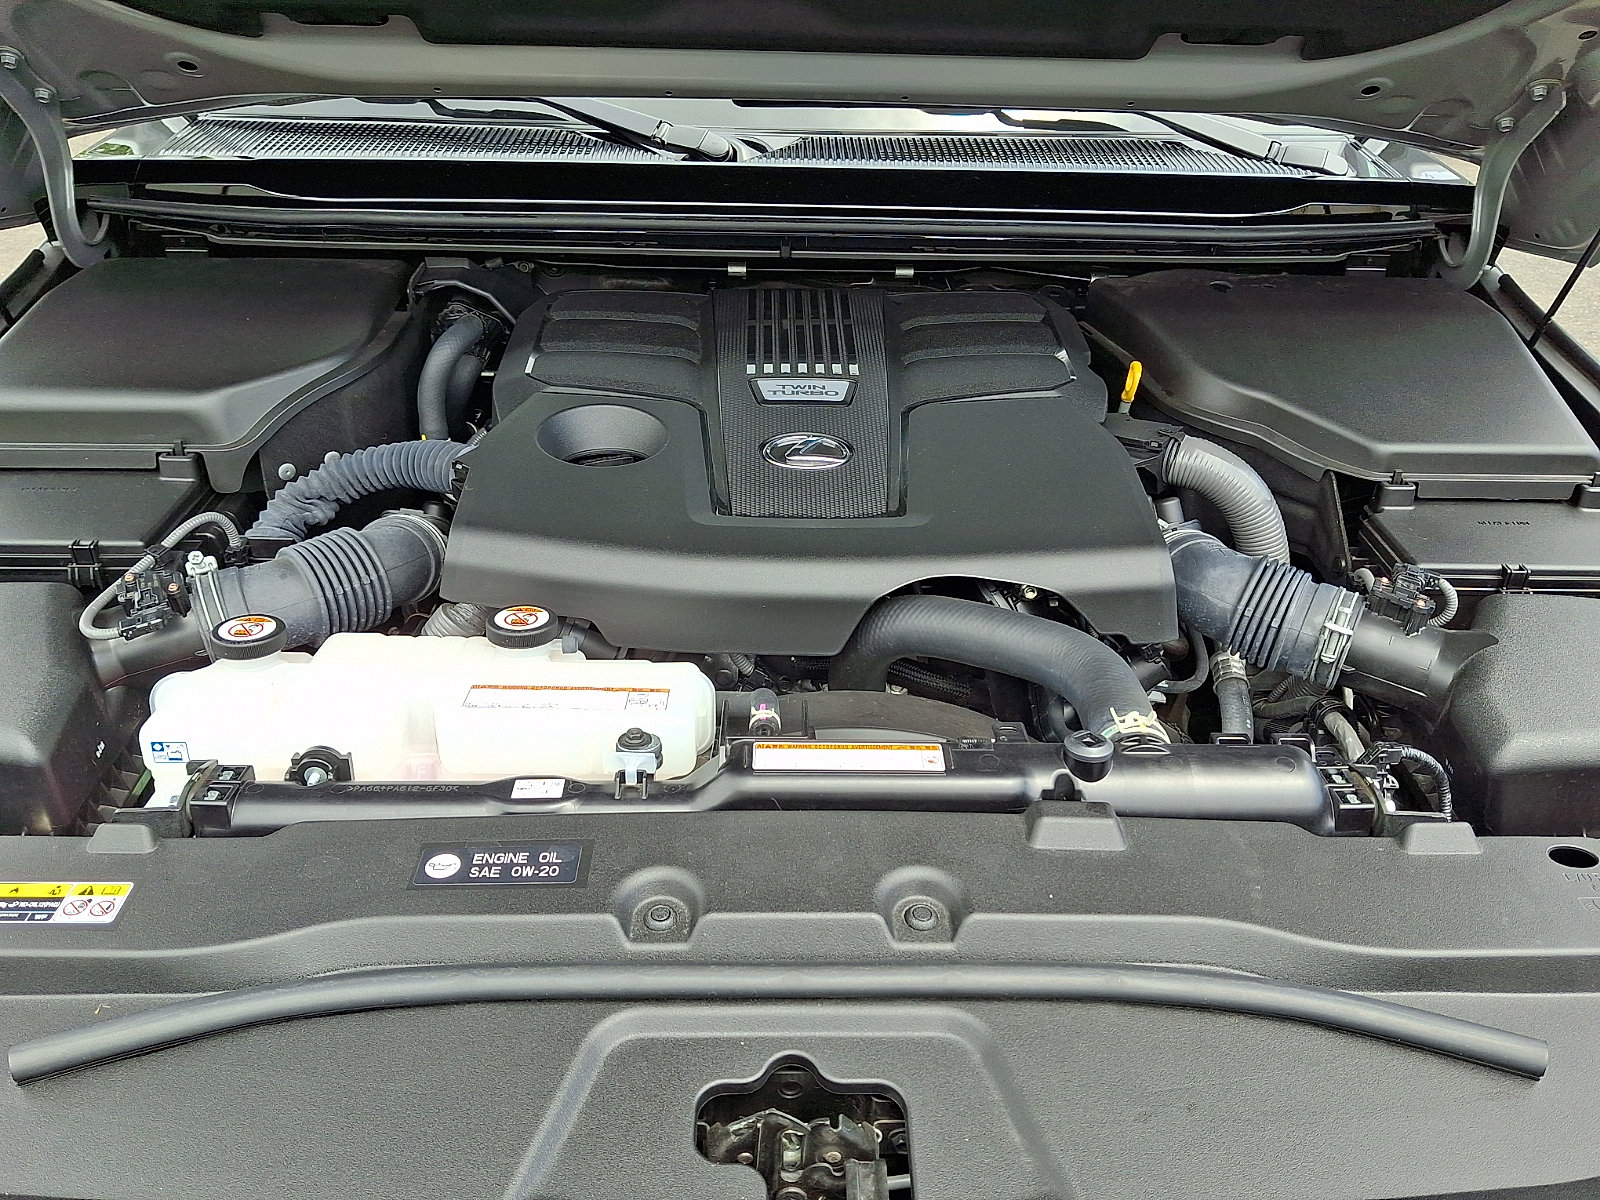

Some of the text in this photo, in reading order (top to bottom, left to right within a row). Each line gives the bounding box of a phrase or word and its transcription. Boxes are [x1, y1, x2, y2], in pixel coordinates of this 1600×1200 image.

[472, 852, 563, 865] ENGINE OIL
[468, 865, 560, 878] SAE 0W-20
